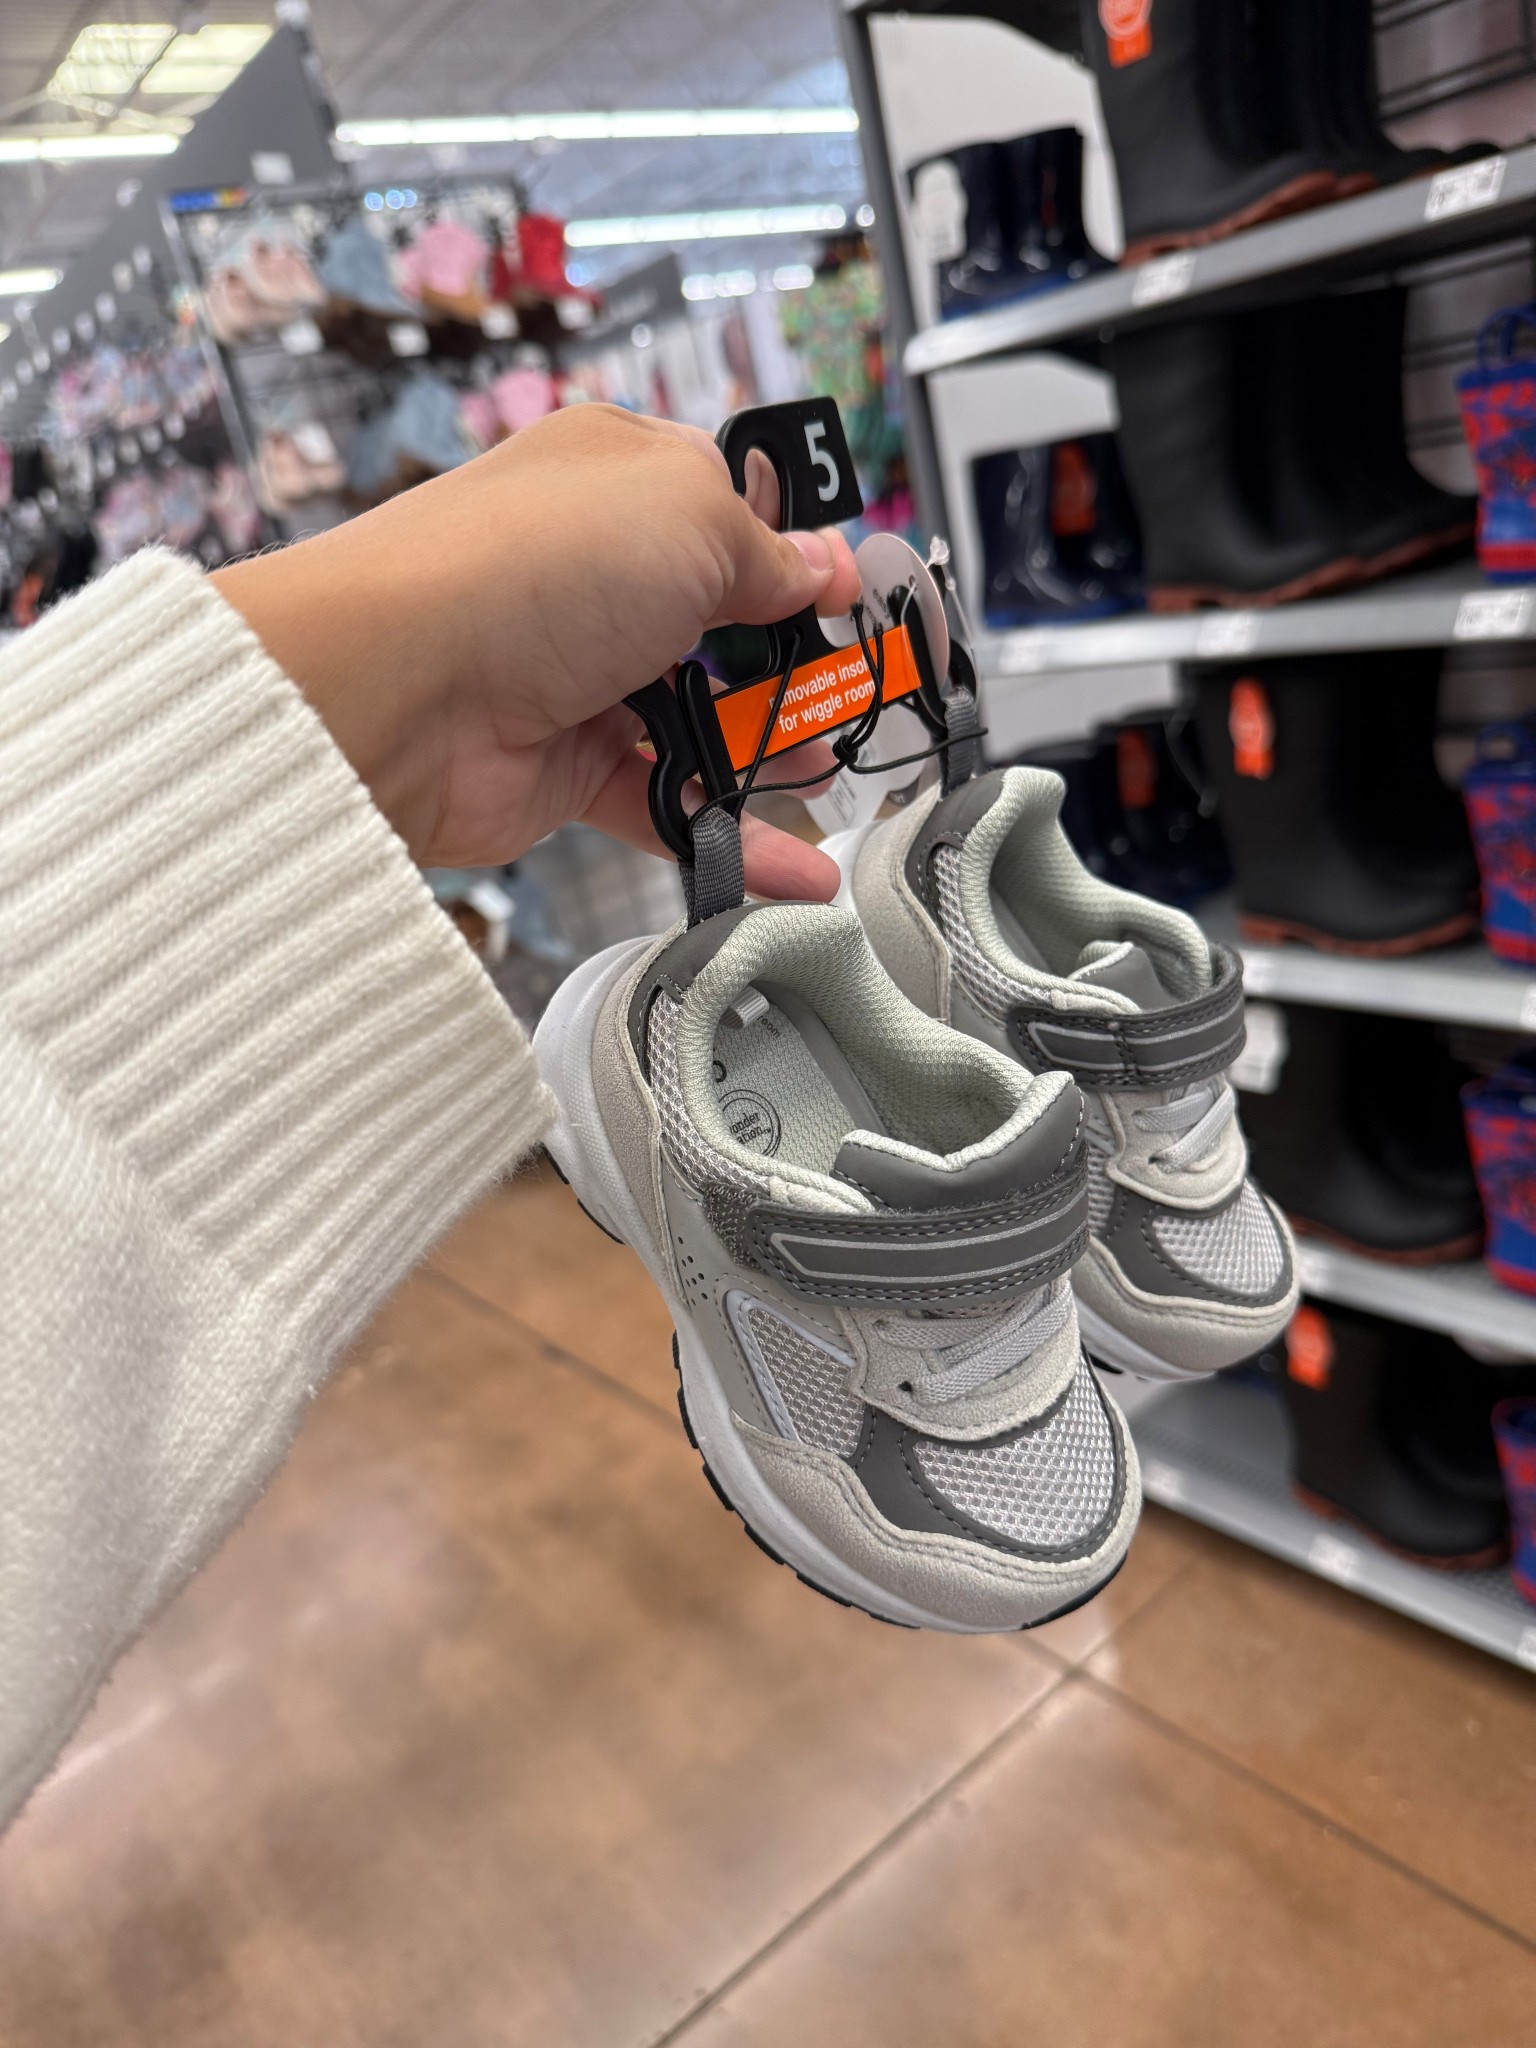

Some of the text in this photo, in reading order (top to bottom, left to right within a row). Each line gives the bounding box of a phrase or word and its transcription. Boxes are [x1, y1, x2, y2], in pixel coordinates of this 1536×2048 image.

[803, 421, 840, 502] 5
[768, 654, 870, 710] rmovable insol
[779, 680, 876, 734] for wiggle room
